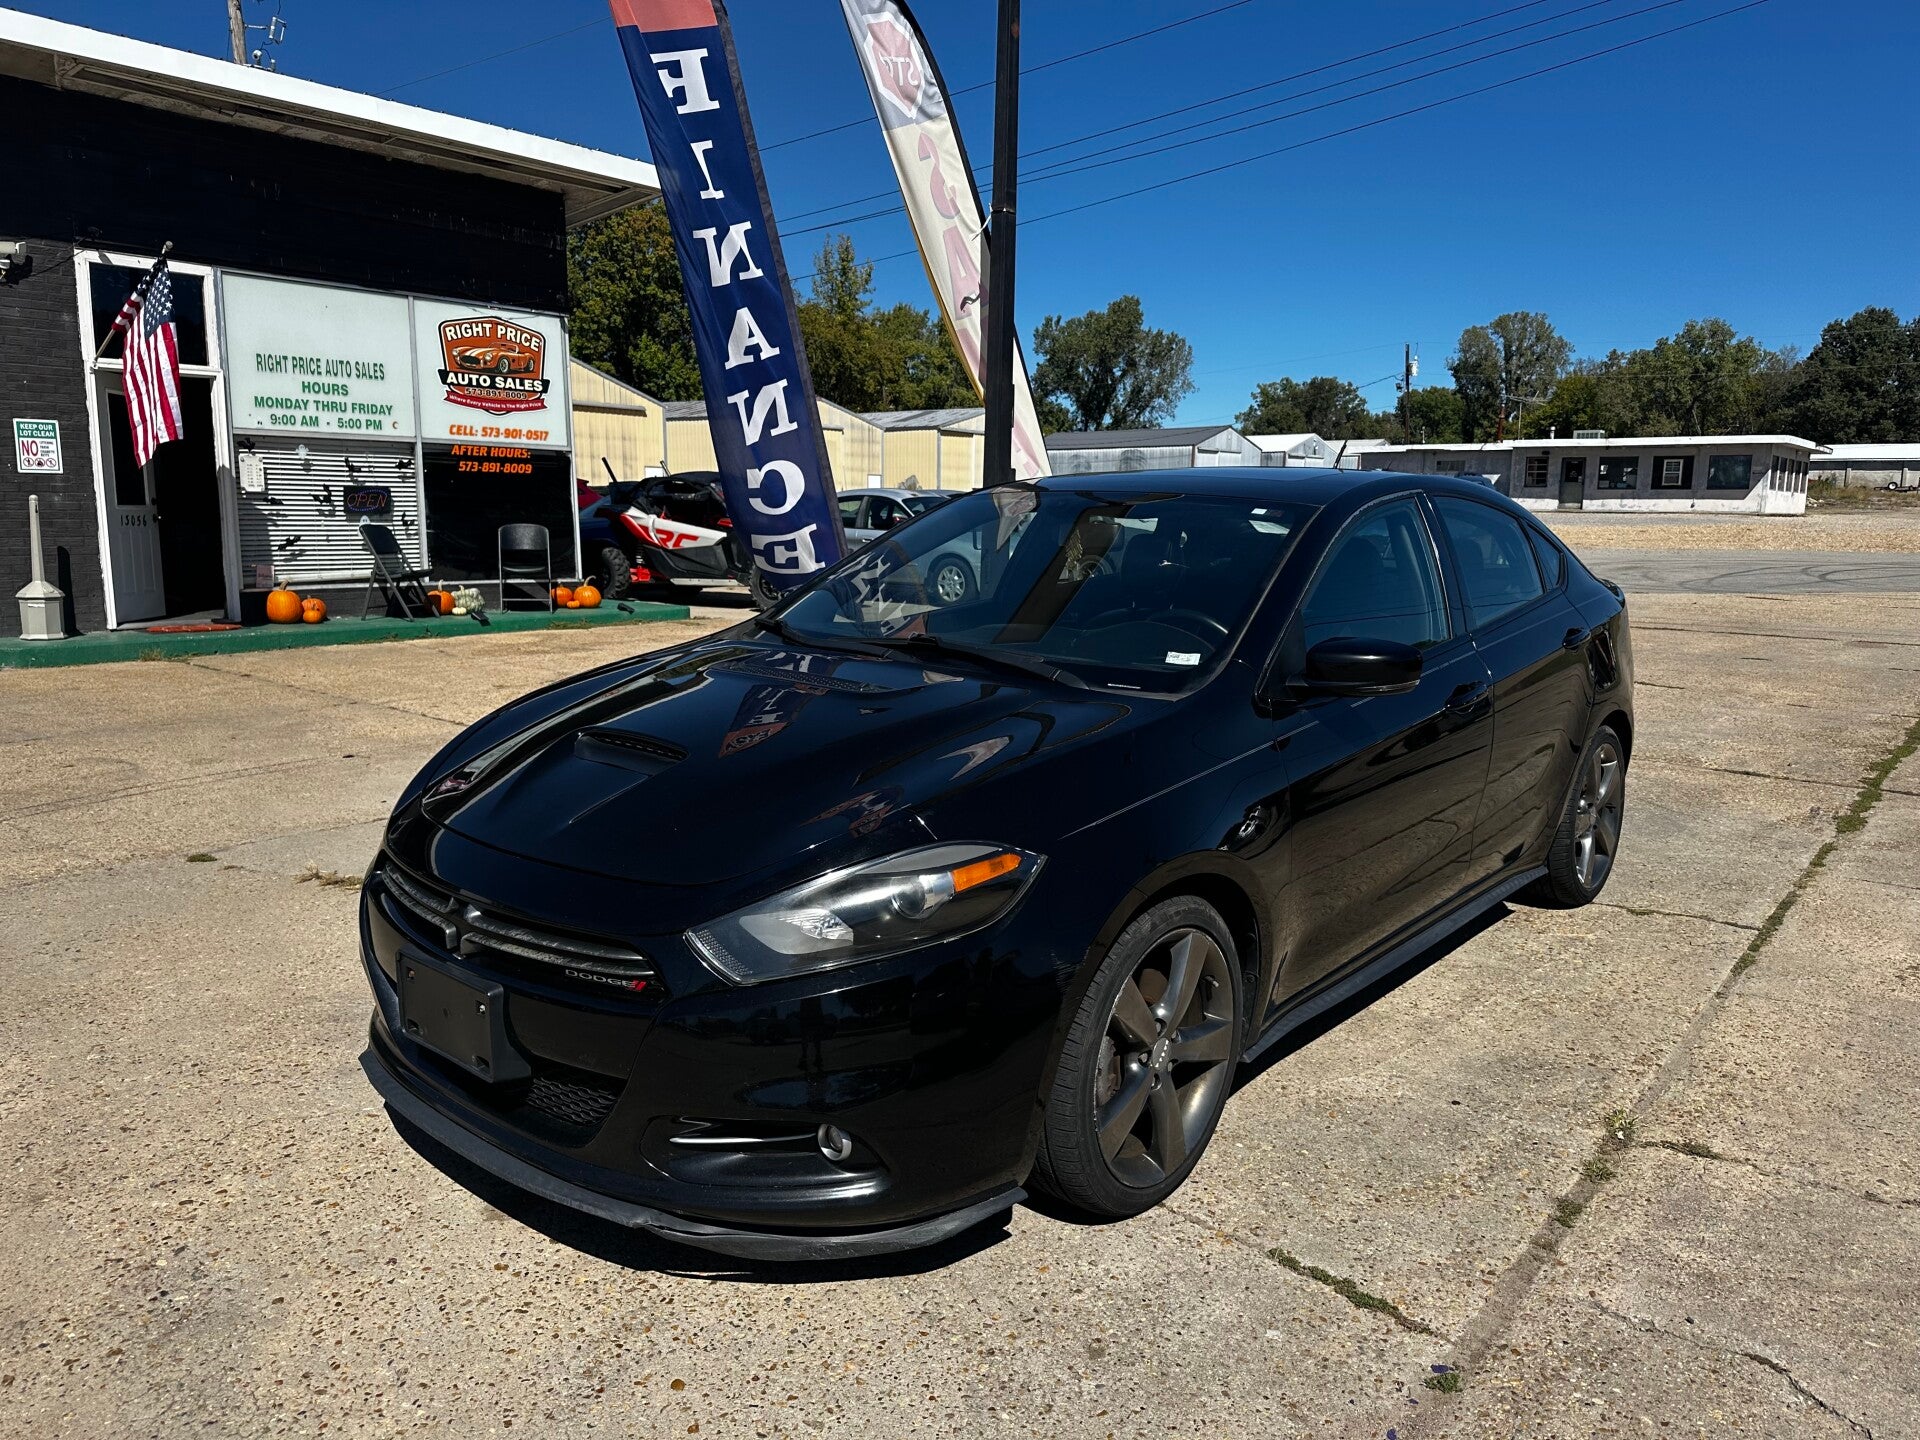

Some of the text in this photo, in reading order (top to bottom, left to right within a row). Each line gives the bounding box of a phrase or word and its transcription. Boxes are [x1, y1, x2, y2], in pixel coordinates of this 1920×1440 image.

[445, 322, 540, 351] RIGHT PRICE
[256, 353, 385, 381] RIGHT PRICE AUTO SALES
[301, 381, 349, 396] HOURS
[446, 372, 543, 392] AUTO SALES
[449, 395, 466, 403] Where
[467, 398, 481, 406] Every
[465, 388, 527, 399] 573-891-8009
[254, 396, 393, 416] MONDAY THRU FRIDAY
[270, 413, 296, 426] 9:00
[300, 415, 319, 427] AM
[337, 417, 362, 429] 5:00
[365, 419, 382, 430] PM
[449, 424, 549, 441] CELL: 573-901-0517
[21, 439, 39, 457] NO
[451, 444, 531, 459] AFTER HOURS:
[458, 461, 532, 474] 573-891-8009
[347, 492, 388, 508] OPEN
[565, 969, 637, 988] DODGE
